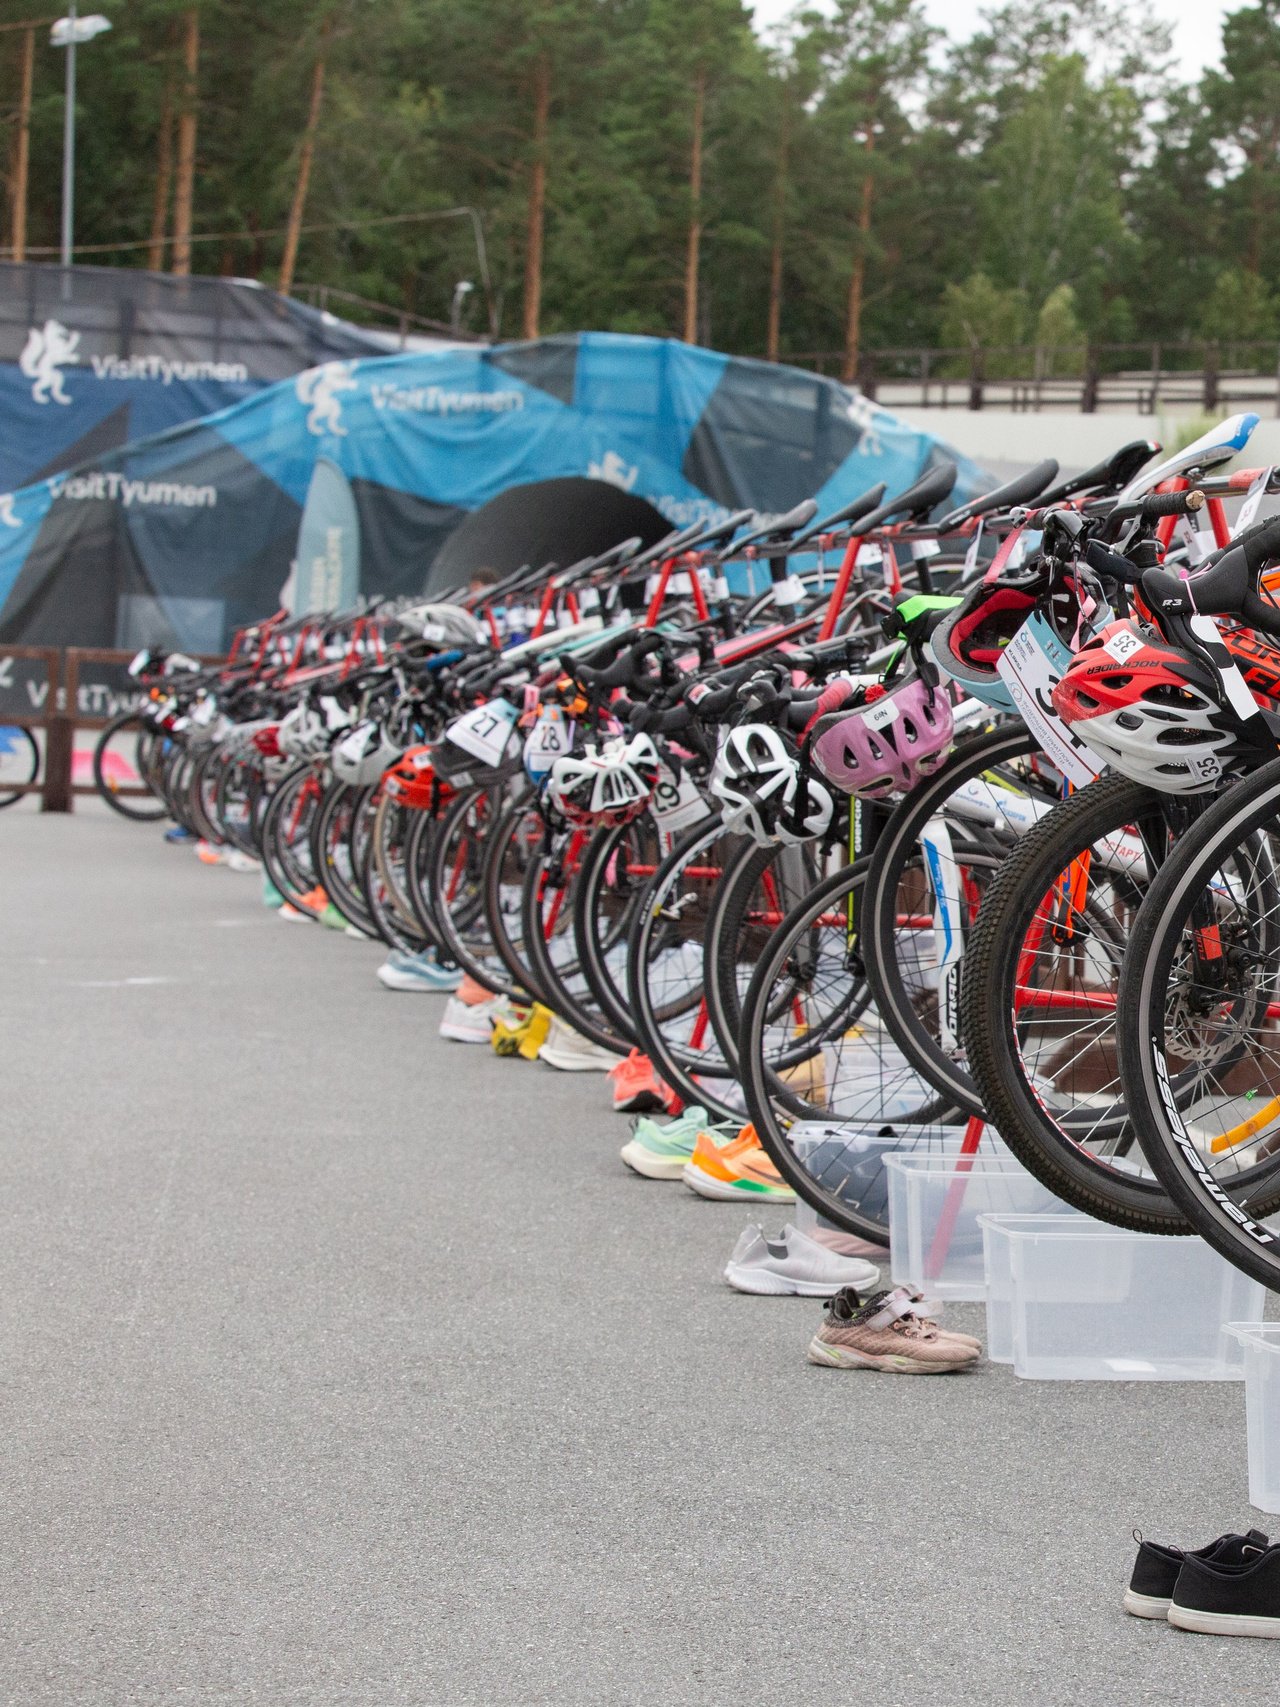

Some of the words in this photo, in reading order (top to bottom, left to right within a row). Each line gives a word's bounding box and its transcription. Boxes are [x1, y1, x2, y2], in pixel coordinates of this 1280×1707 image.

[90, 354, 249, 386] VisitTyumen
[370, 382, 524, 418] VisitTyumen
[48, 471, 218, 507] VisitTyumen
[1162, 598, 1182, 607] R3
[1113, 635, 1137, 653] 35
[1087, 660, 1160, 675] ROCKRIDER
[470, 712, 498, 737] 27
[542, 723, 561, 751] 28
[1197, 757, 1219, 778] 35
[655, 781, 681, 813] 29
[948, 967, 958, 1036] DRAG
